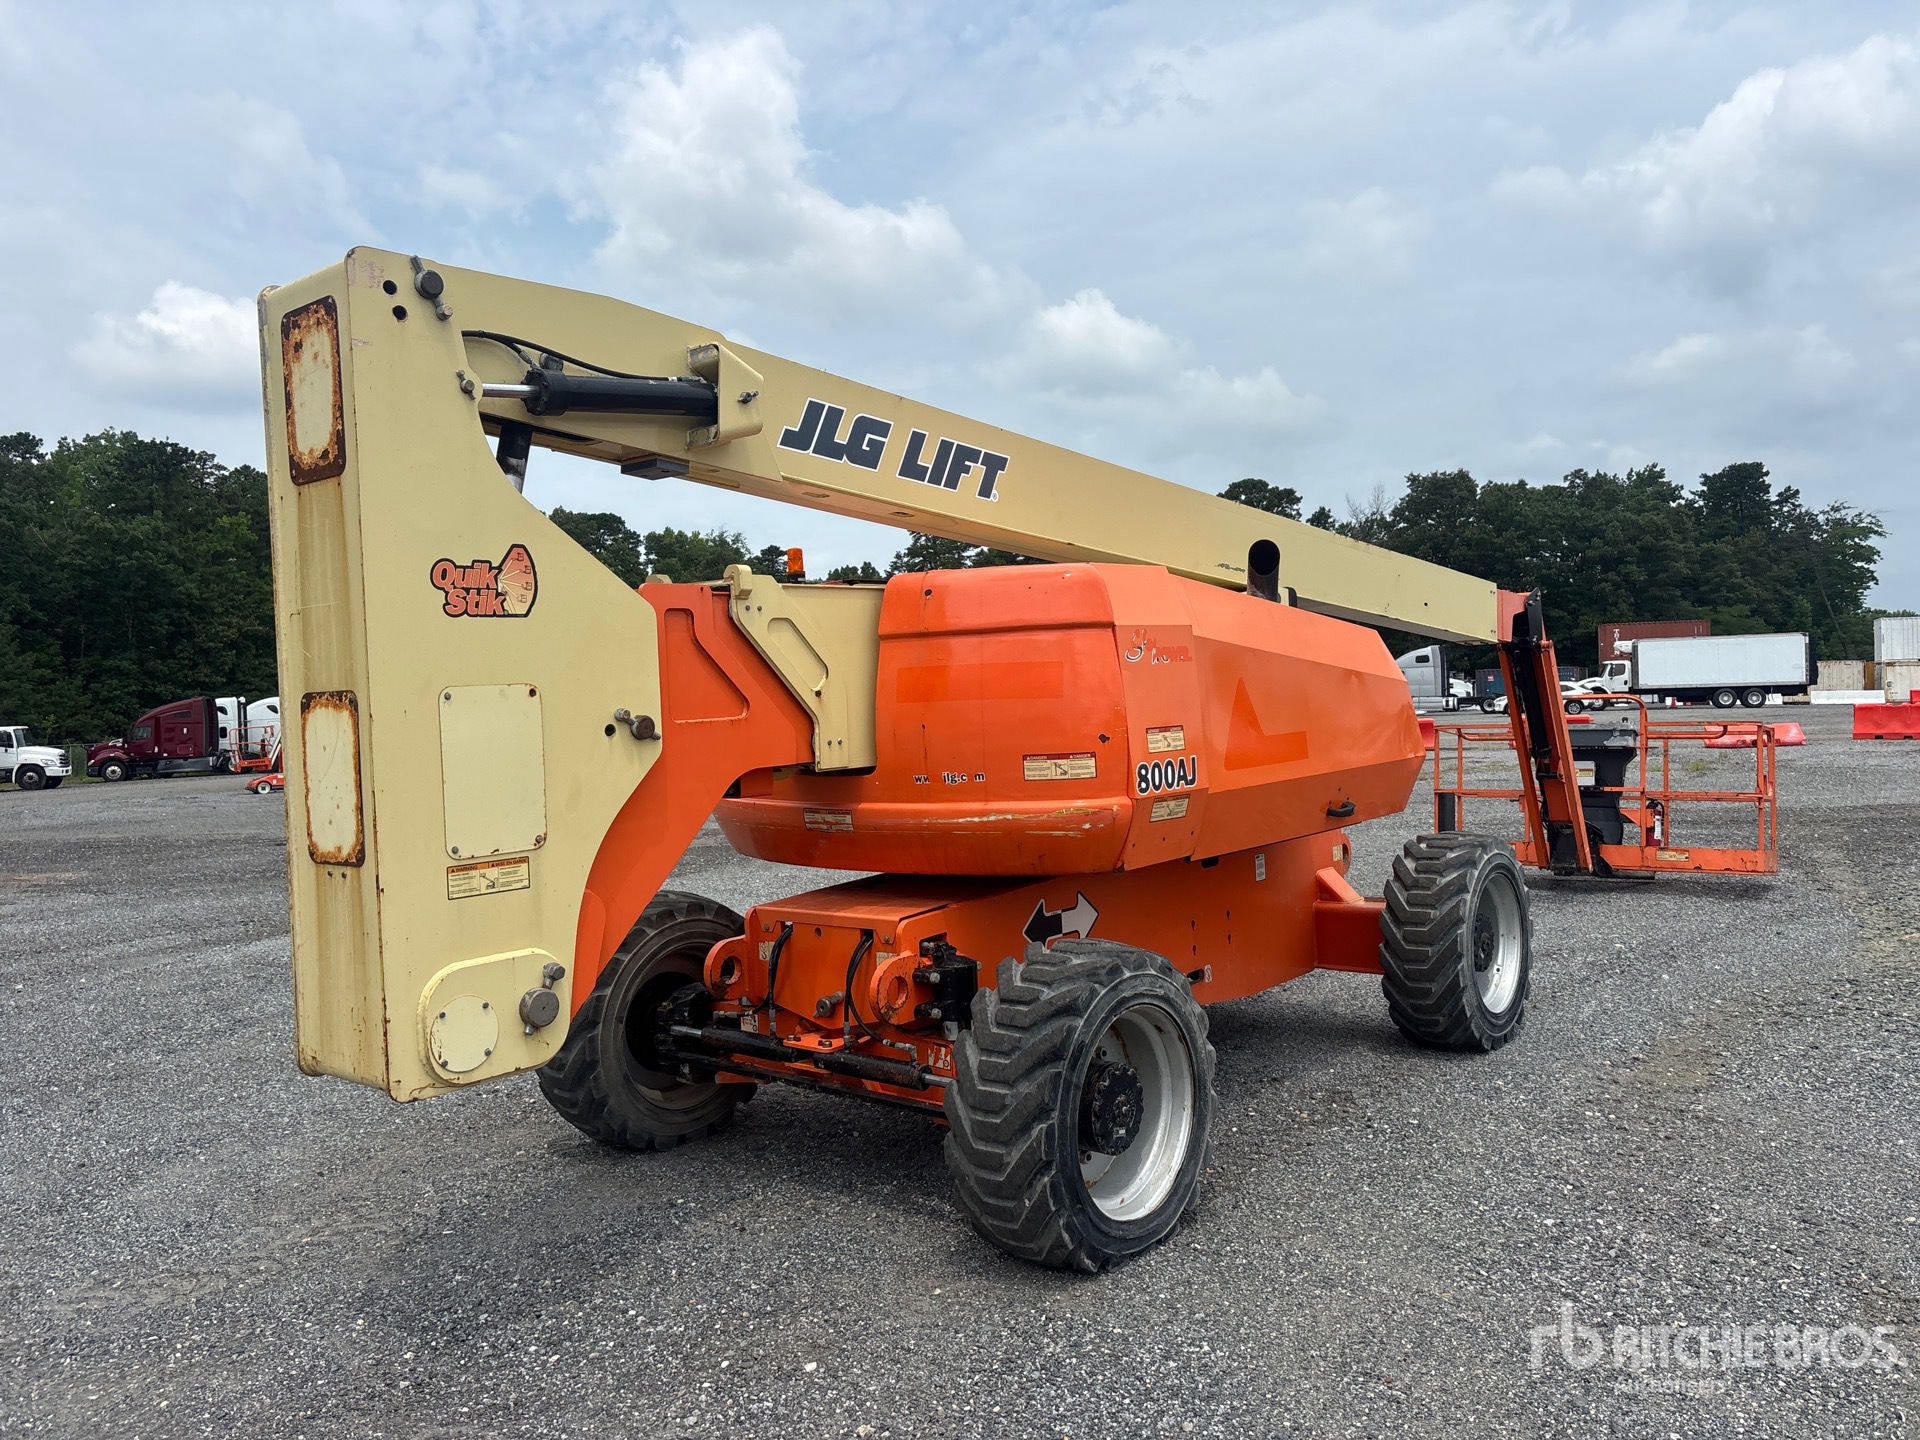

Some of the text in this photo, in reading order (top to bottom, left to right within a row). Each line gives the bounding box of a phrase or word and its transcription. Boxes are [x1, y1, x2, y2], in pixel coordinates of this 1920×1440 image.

[778, 398, 1010, 501] JLG LIFT
[432, 560, 499, 593] Quik
[444, 588, 506, 615] Stik
[1136, 755, 1197, 795] 800AJ
